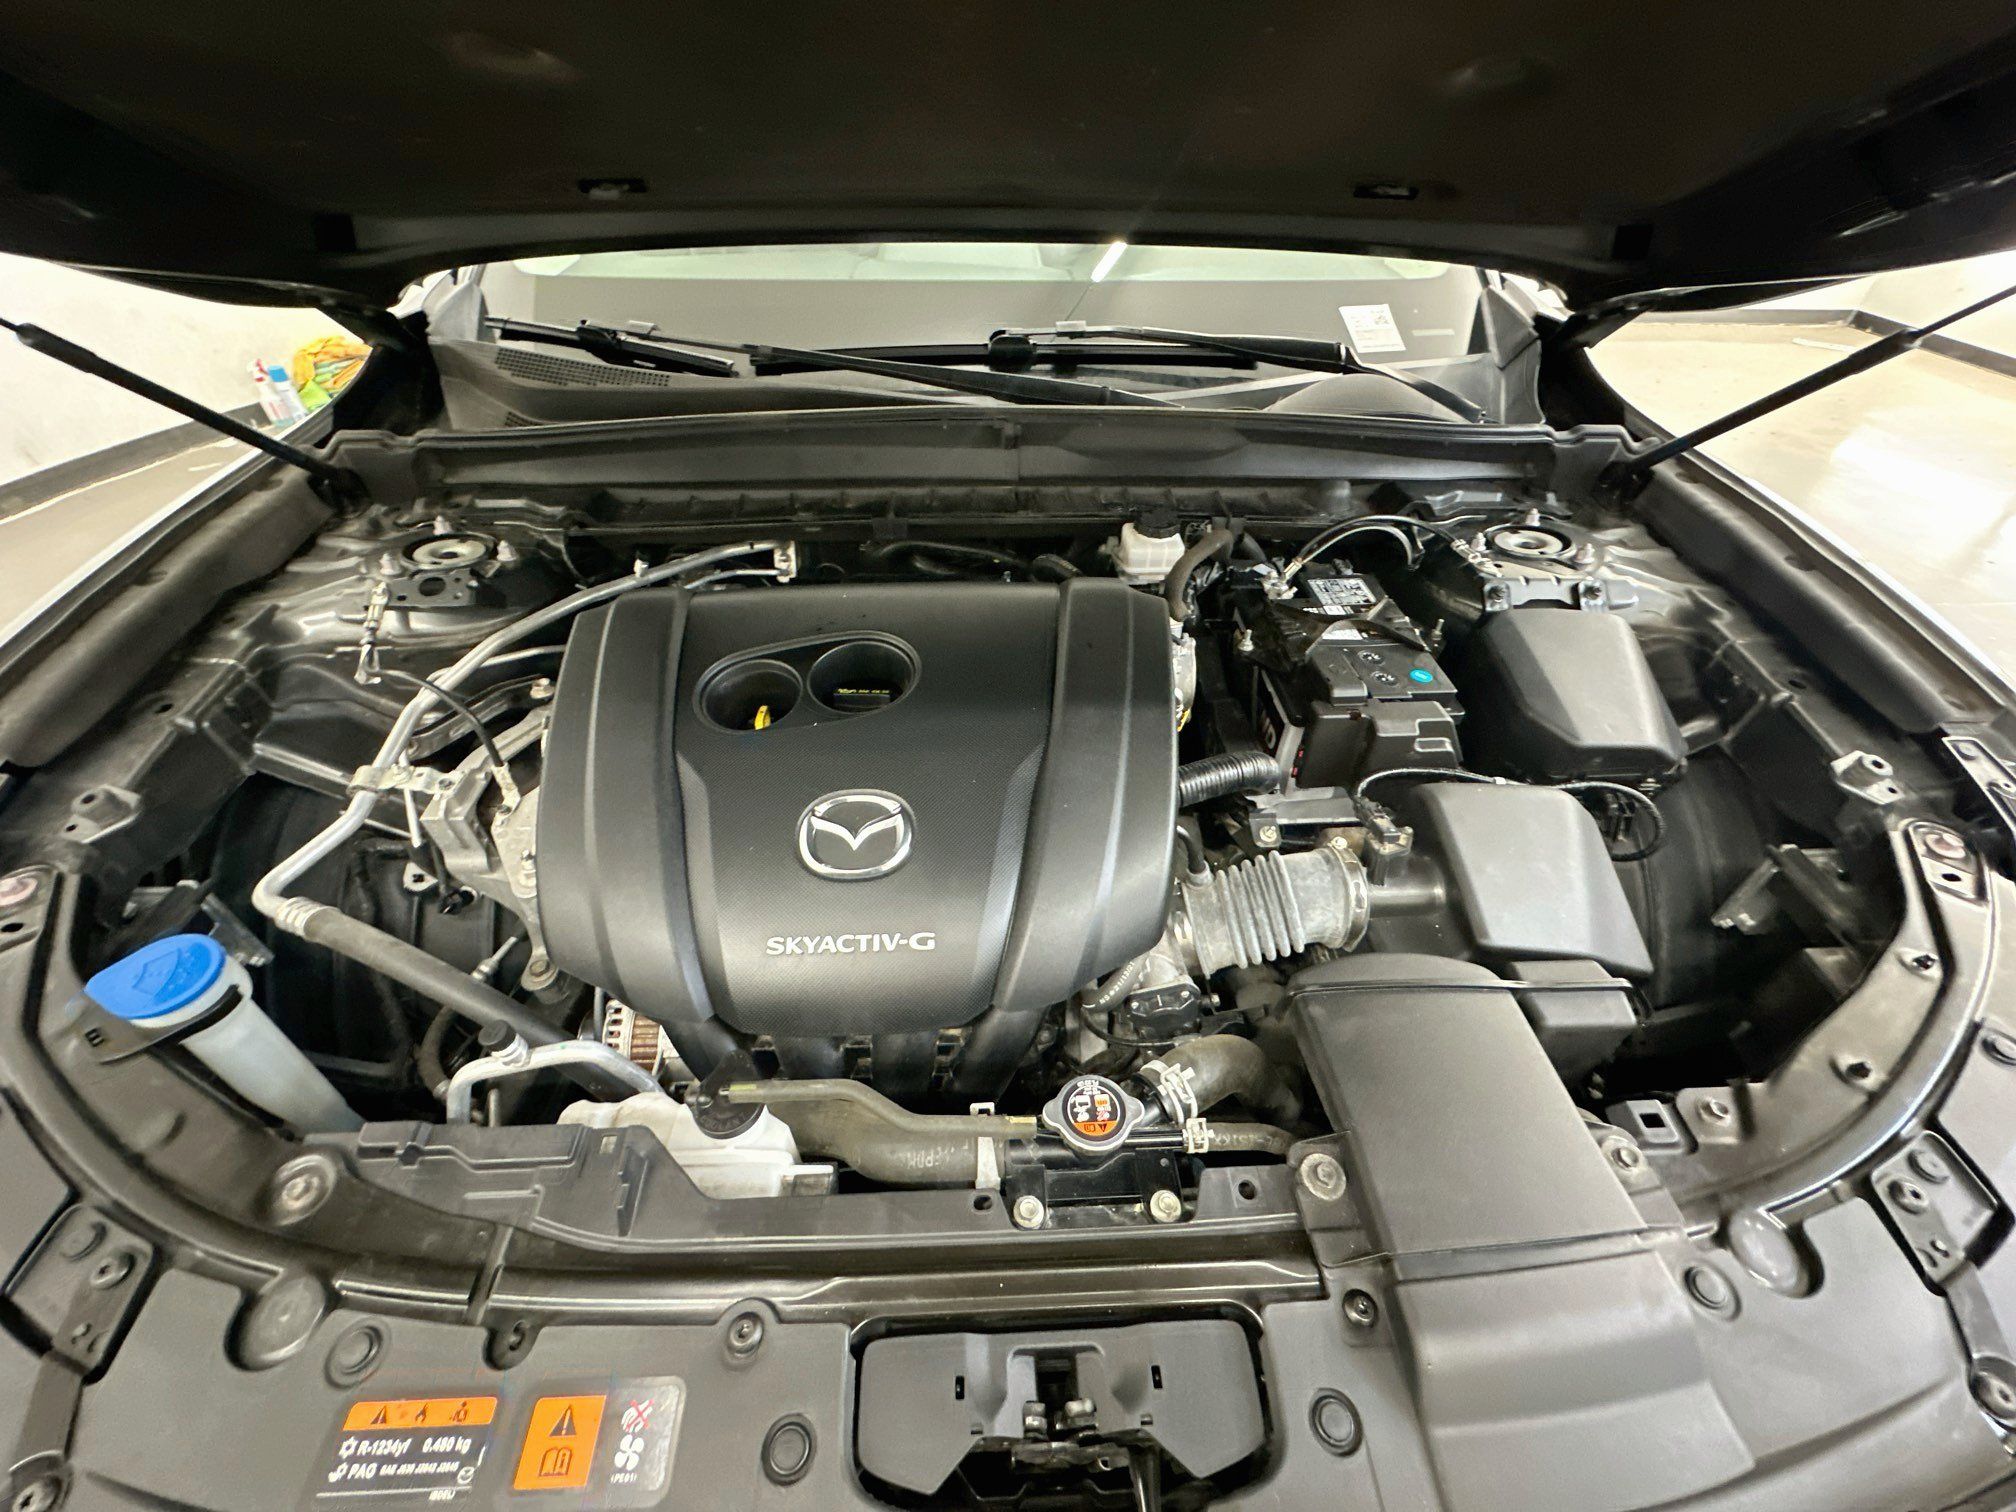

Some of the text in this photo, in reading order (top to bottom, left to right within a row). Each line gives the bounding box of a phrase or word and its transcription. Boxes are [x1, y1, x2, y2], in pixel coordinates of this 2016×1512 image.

[766, 932, 936, 955] SKYACTIV-G
[356, 1437, 413, 1457] R-1234yf
[455, 1435, 472, 1454] kg
